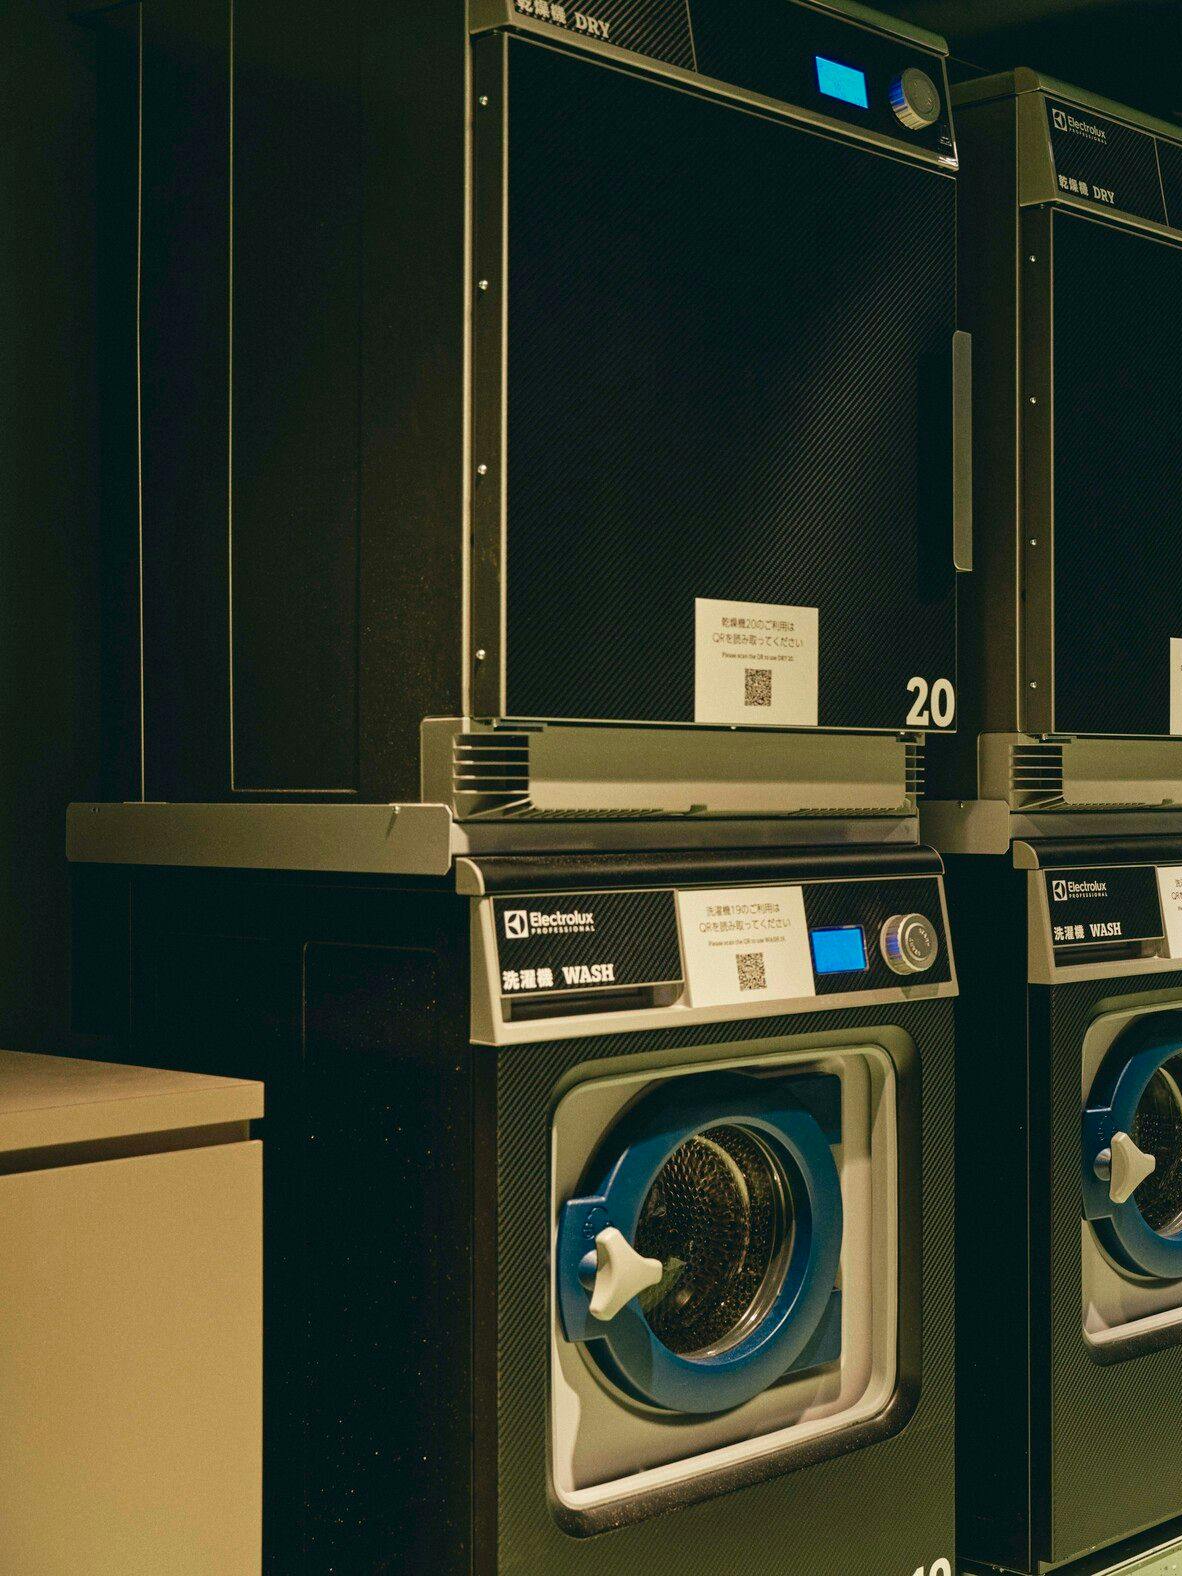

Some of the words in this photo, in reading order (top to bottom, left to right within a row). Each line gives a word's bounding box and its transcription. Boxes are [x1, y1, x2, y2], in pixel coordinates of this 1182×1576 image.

[574, 12, 610, 39] DRY
[1068, 116, 1106, 139] Electrolux
[1092, 185, 1115, 204] DRY
[906, 676, 955, 728] 20
[1067, 881, 1107, 892] Electrolux
[530, 910, 594, 927] Electrolux
[531, 925, 595, 934] PROFESSIONAL
[1089, 922, 1122, 937] WASH
[502, 967, 554, 990] 洗濯機
[562, 963, 615, 985] WASH
